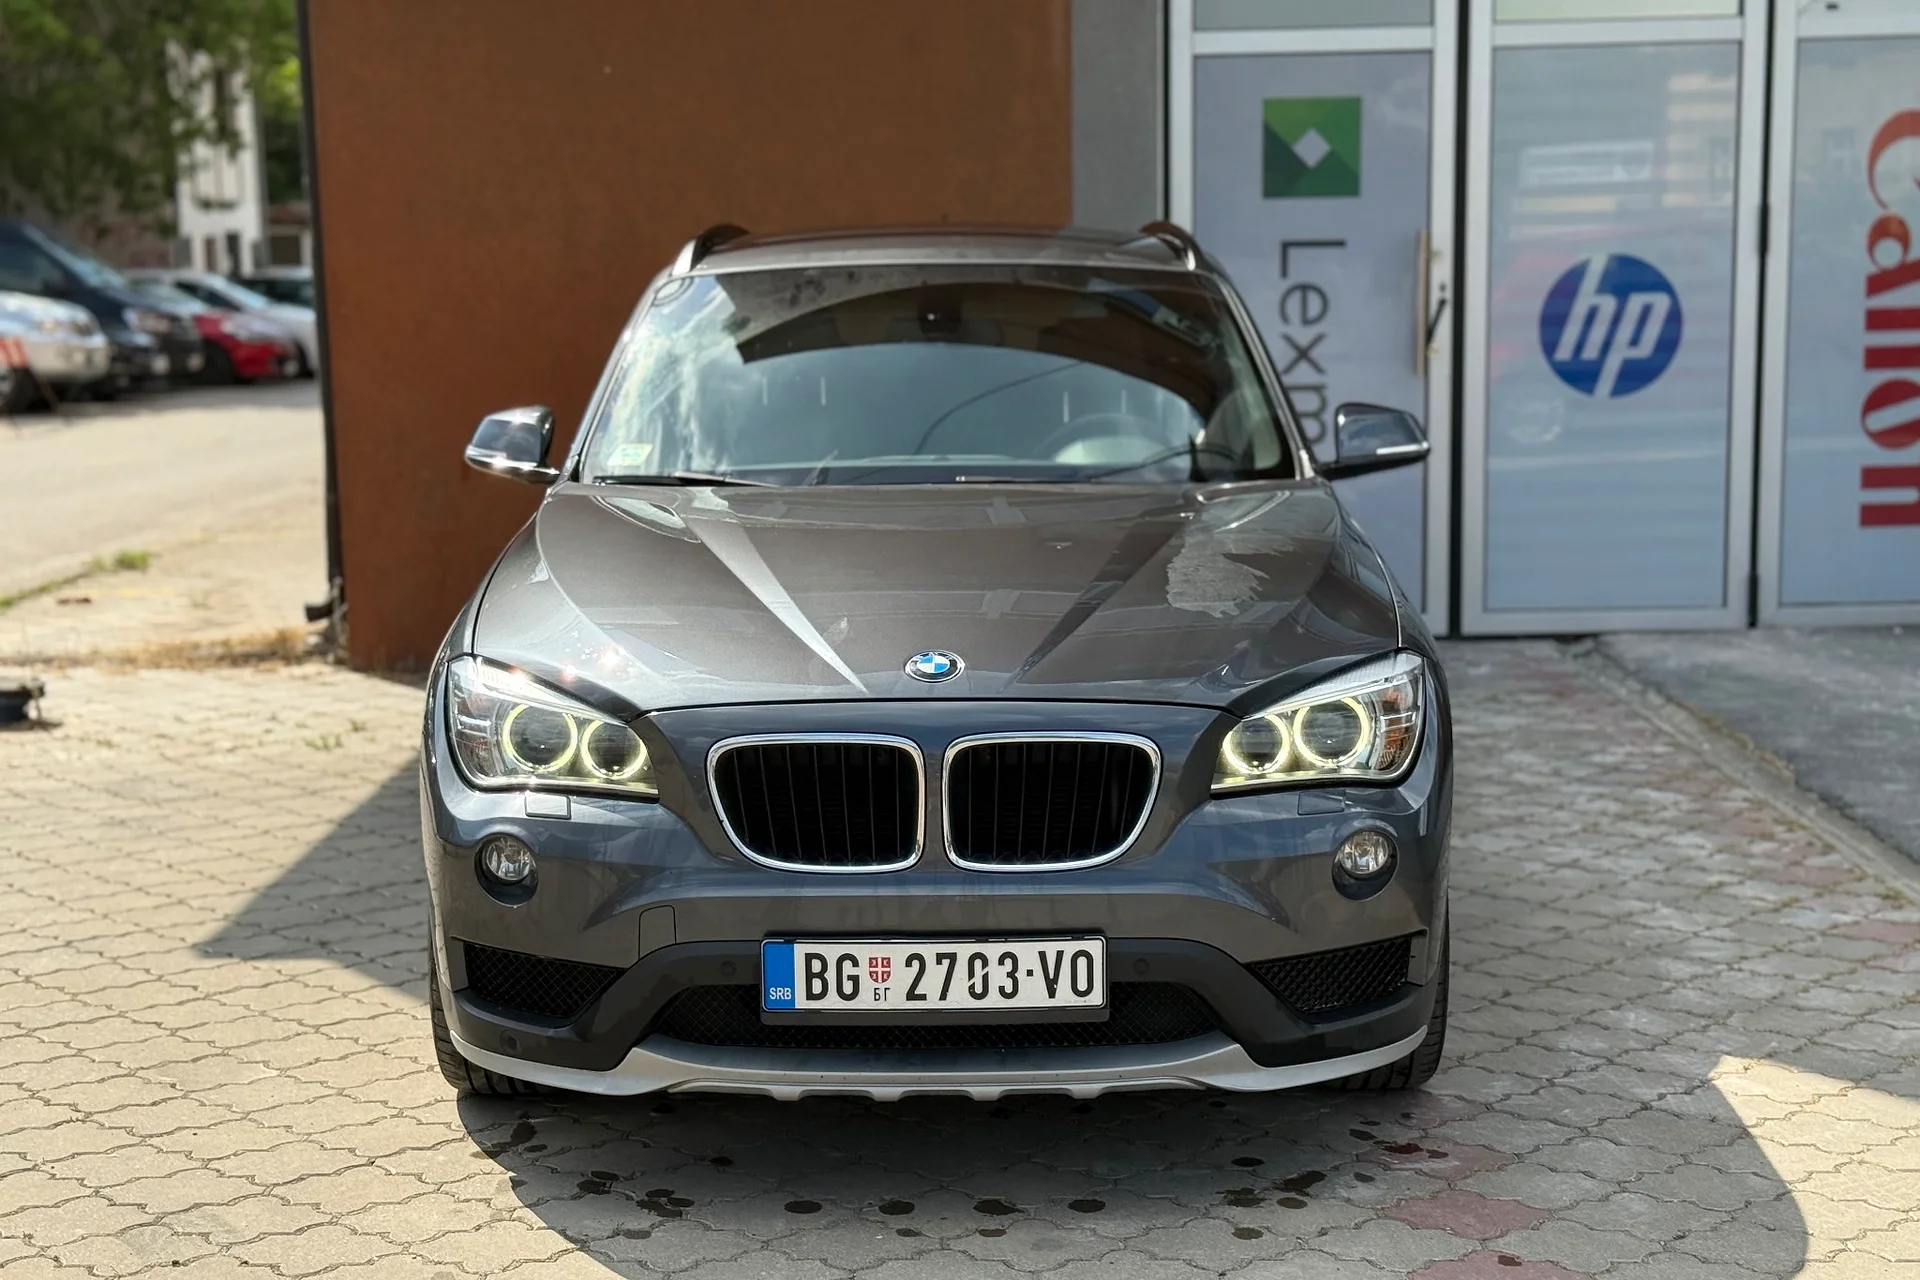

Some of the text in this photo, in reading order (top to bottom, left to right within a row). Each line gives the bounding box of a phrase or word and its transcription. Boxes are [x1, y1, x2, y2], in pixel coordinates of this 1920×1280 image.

[1552, 254, 1672, 397] hp
[769, 987, 792, 1000] SRB
[804, 952, 860, 1002] BG
